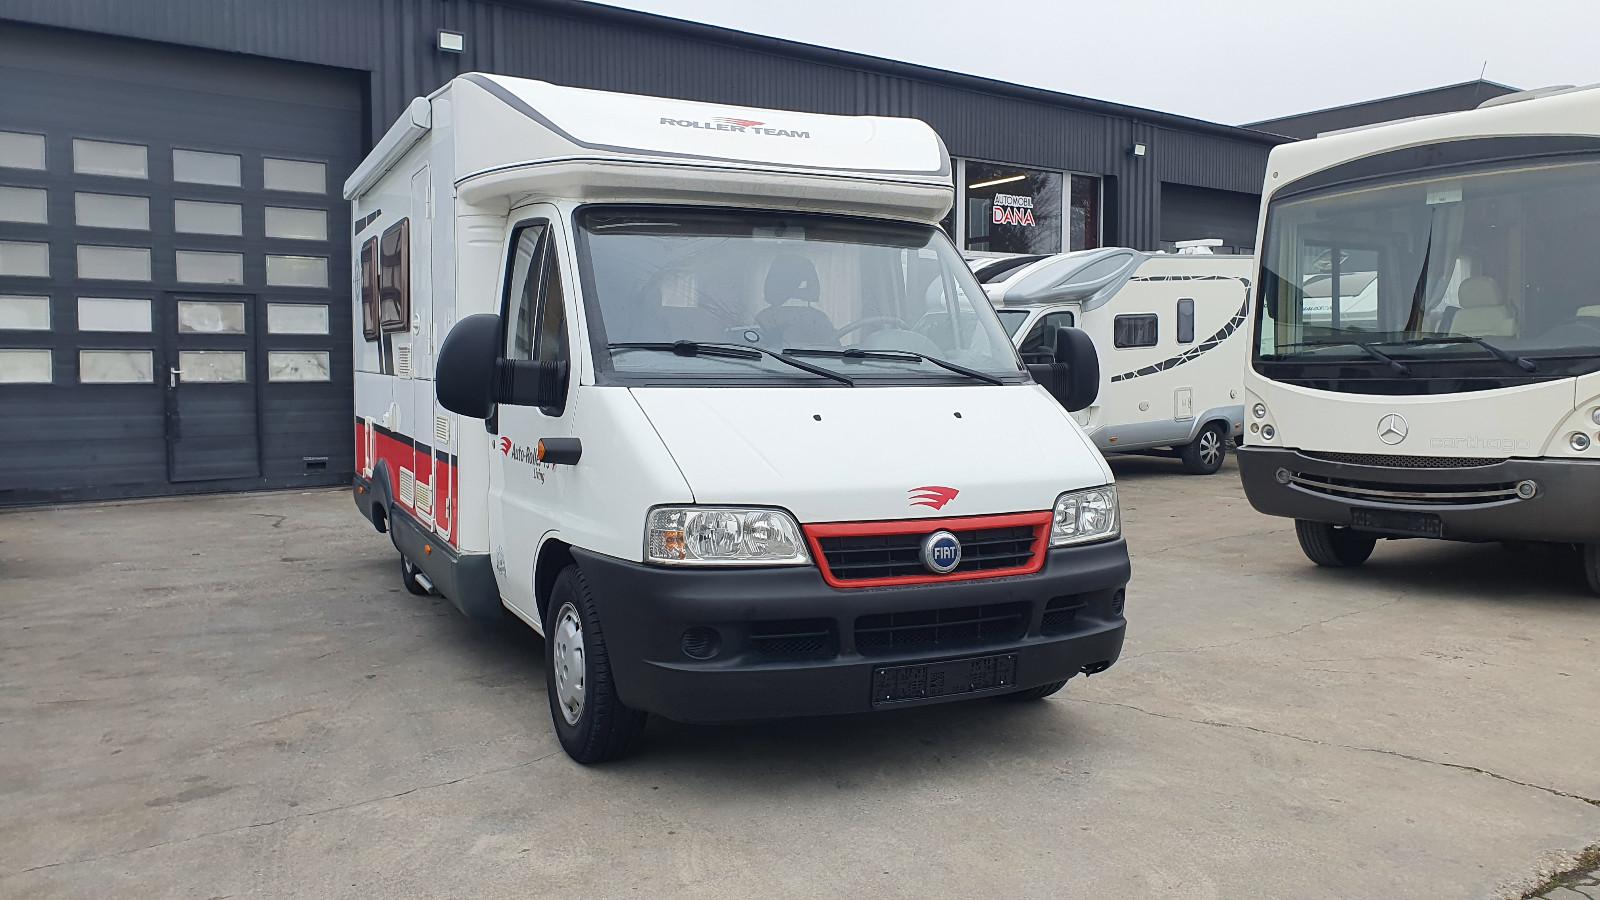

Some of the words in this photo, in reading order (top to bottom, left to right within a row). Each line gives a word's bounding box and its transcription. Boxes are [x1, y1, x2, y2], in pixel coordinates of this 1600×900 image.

[660, 117, 745, 133] ROLLER
[752, 126, 810, 139] TEAM
[994, 193, 1033, 208] AUTOMOBIL
[993, 206, 1035, 226] DANA
[512, 442, 541, 466] Auto-Roll
[1429, 435, 1532, 454] carthago
[934, 546, 956, 560] FIAT
